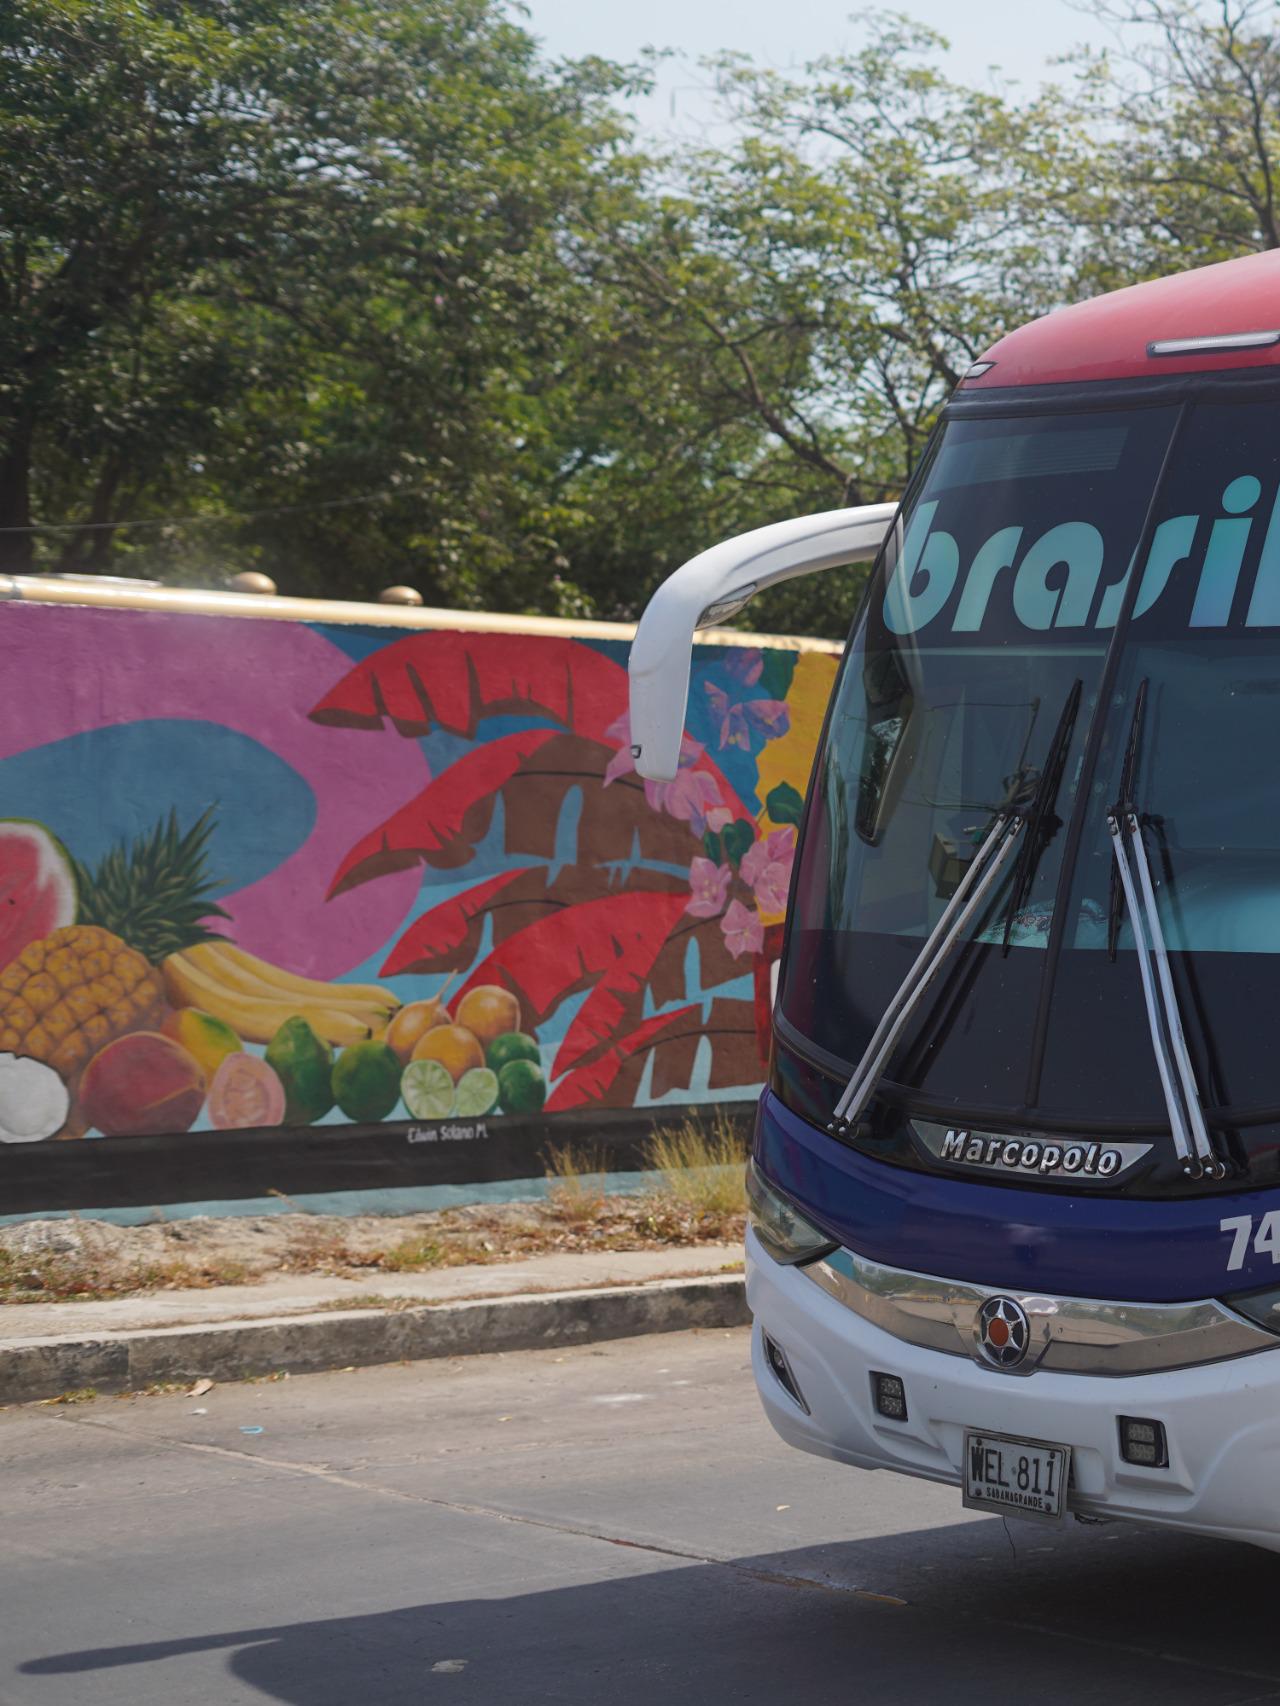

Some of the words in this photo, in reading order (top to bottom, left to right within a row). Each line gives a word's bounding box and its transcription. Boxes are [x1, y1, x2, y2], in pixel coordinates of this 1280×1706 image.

[938, 1129, 1122, 1177] Marcopolo
[970, 1445, 1010, 1488] WEL
[1016, 1456, 1055, 1497] 811
[986, 1486, 1043, 1509] SABANAGRANDE
